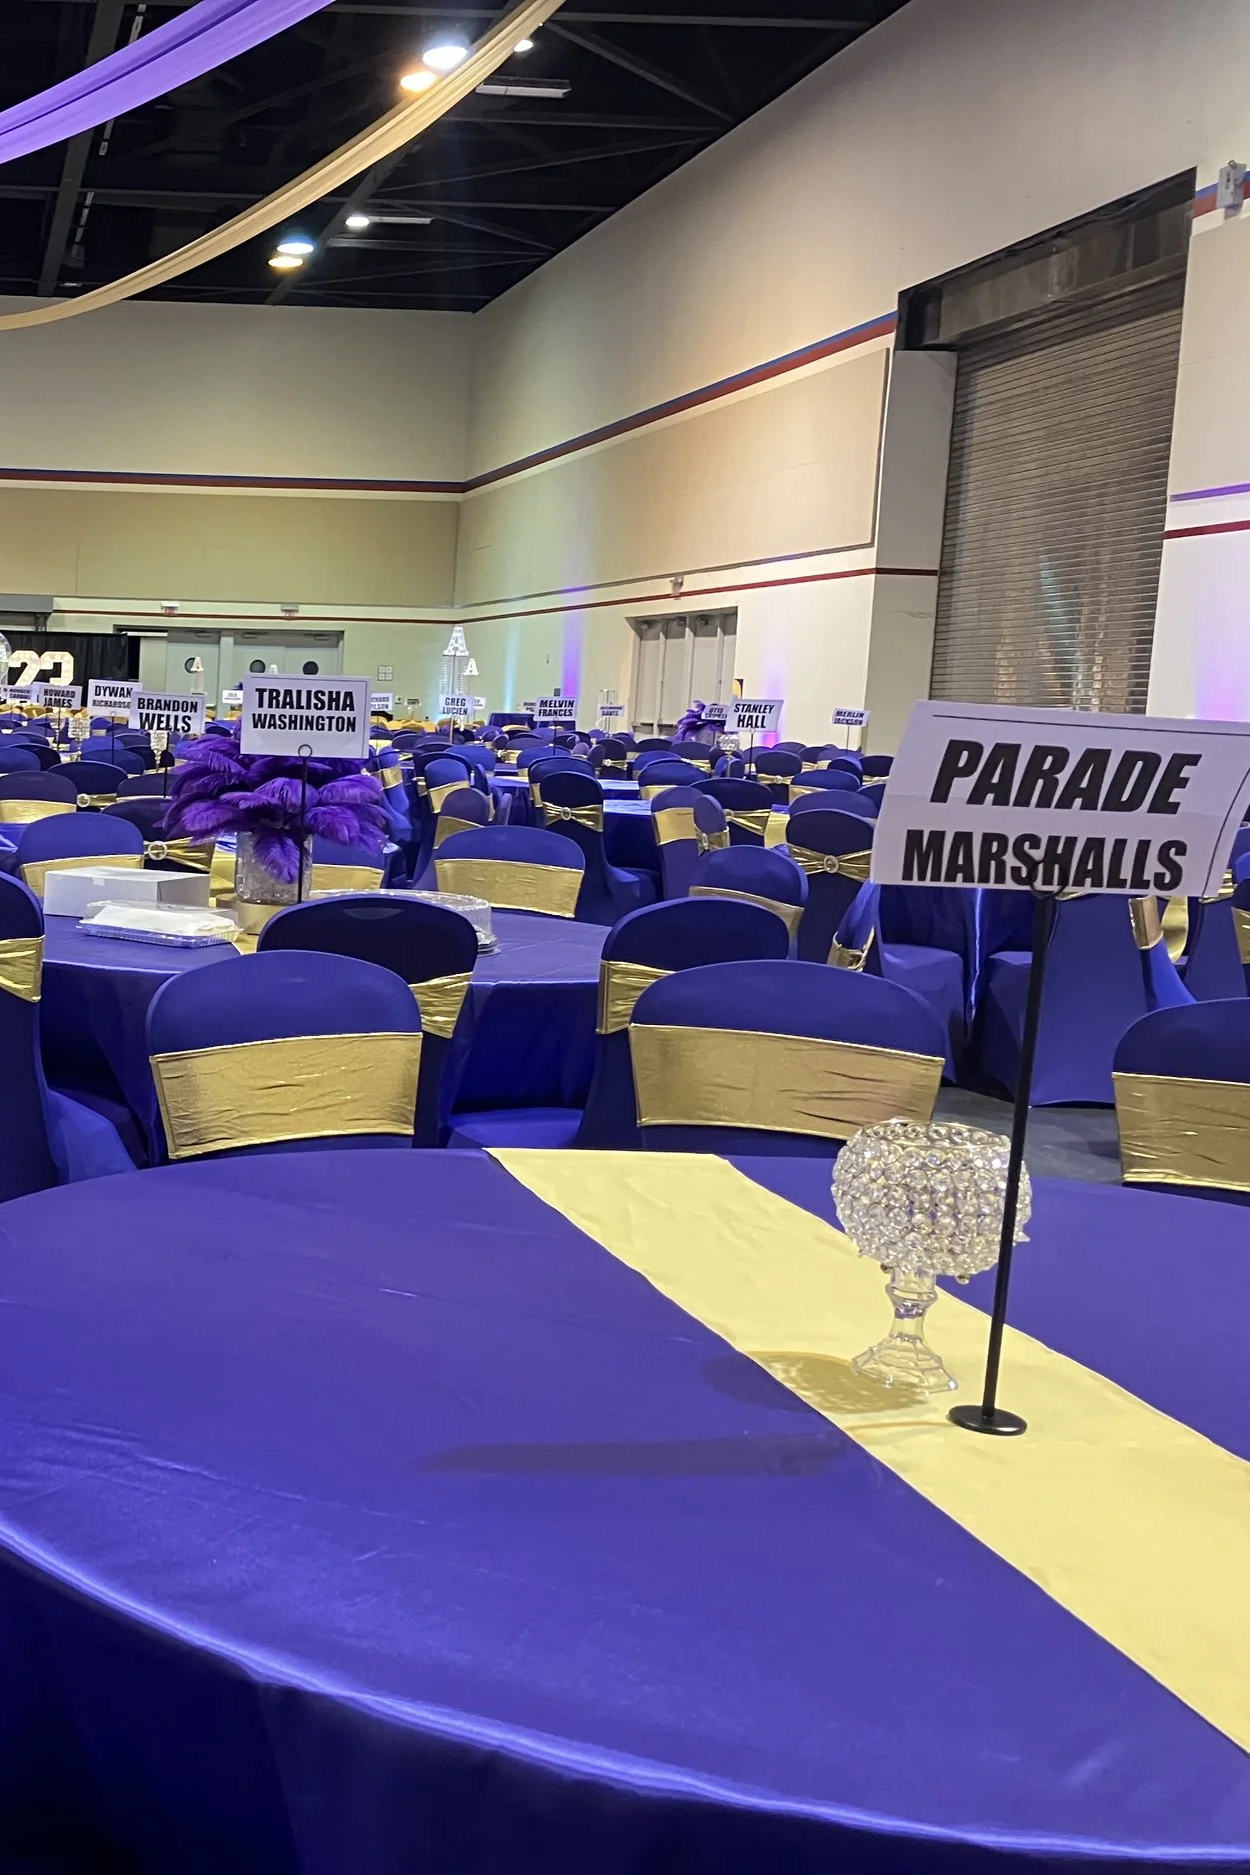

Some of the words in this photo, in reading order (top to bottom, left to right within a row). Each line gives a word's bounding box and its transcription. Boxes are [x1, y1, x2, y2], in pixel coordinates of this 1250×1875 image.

[43, 688, 76, 699] HOWARD
[255, 688, 356, 712] TRALISHA
[43, 697, 73, 709] JAMES
[92, 699, 131, 709] RICHARDSO
[137, 697, 199, 713] BRANDON
[444, 697, 467, 707] GREG
[539, 699, 575, 708] MELVIN
[538, 708, 573, 717] FRANCES
[733, 703, 776, 715] STANLEY
[139, 712, 192, 733] WELLS
[252, 713, 357, 733] WASHINGTON
[736, 714, 767, 729] HALL
[930, 738, 1202, 815] PARADE
[901, 829, 1188, 892] MARSHALLS
